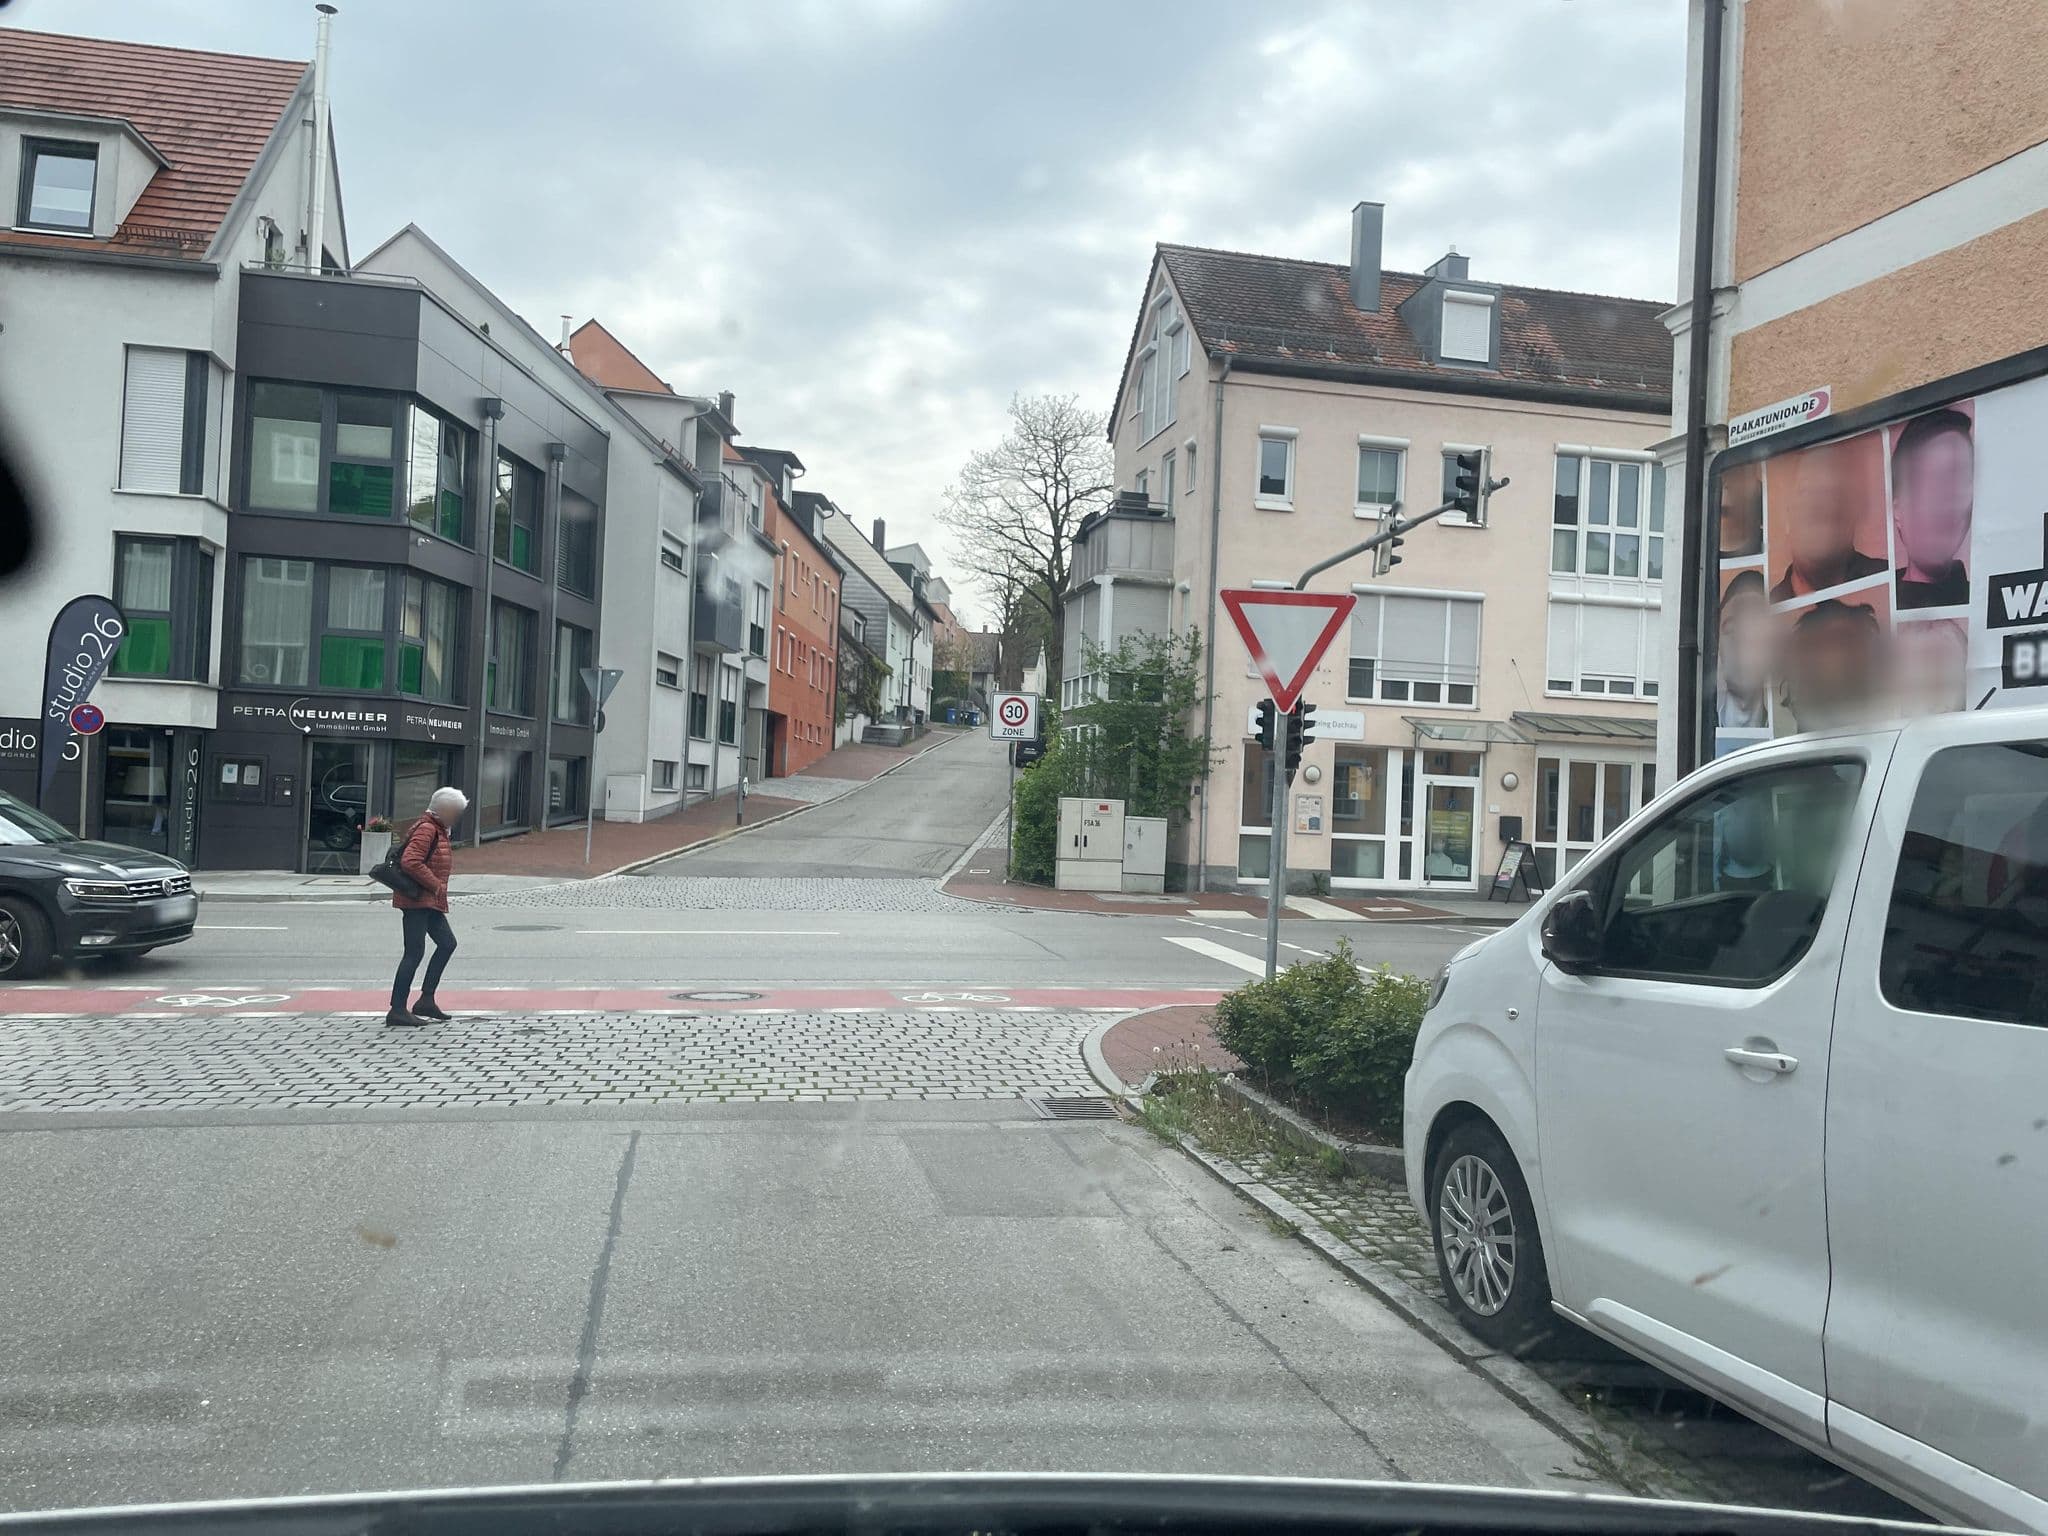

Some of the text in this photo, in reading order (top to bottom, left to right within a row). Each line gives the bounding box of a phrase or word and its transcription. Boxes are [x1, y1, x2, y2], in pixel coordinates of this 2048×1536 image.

[1730, 399, 1815, 436] PLAKATUNION.DE
[49, 613, 123, 723] studio 26
[233, 706, 387, 722] PETRA NEUMEIER
[1005, 705, 1023, 719] 30
[316, 723, 360, 731] Immobilien
[406, 715, 462, 730] PETRA NEUMEIER
[1002, 728, 1025, 736] ZONE
[184, 748, 199, 851] studio 26
